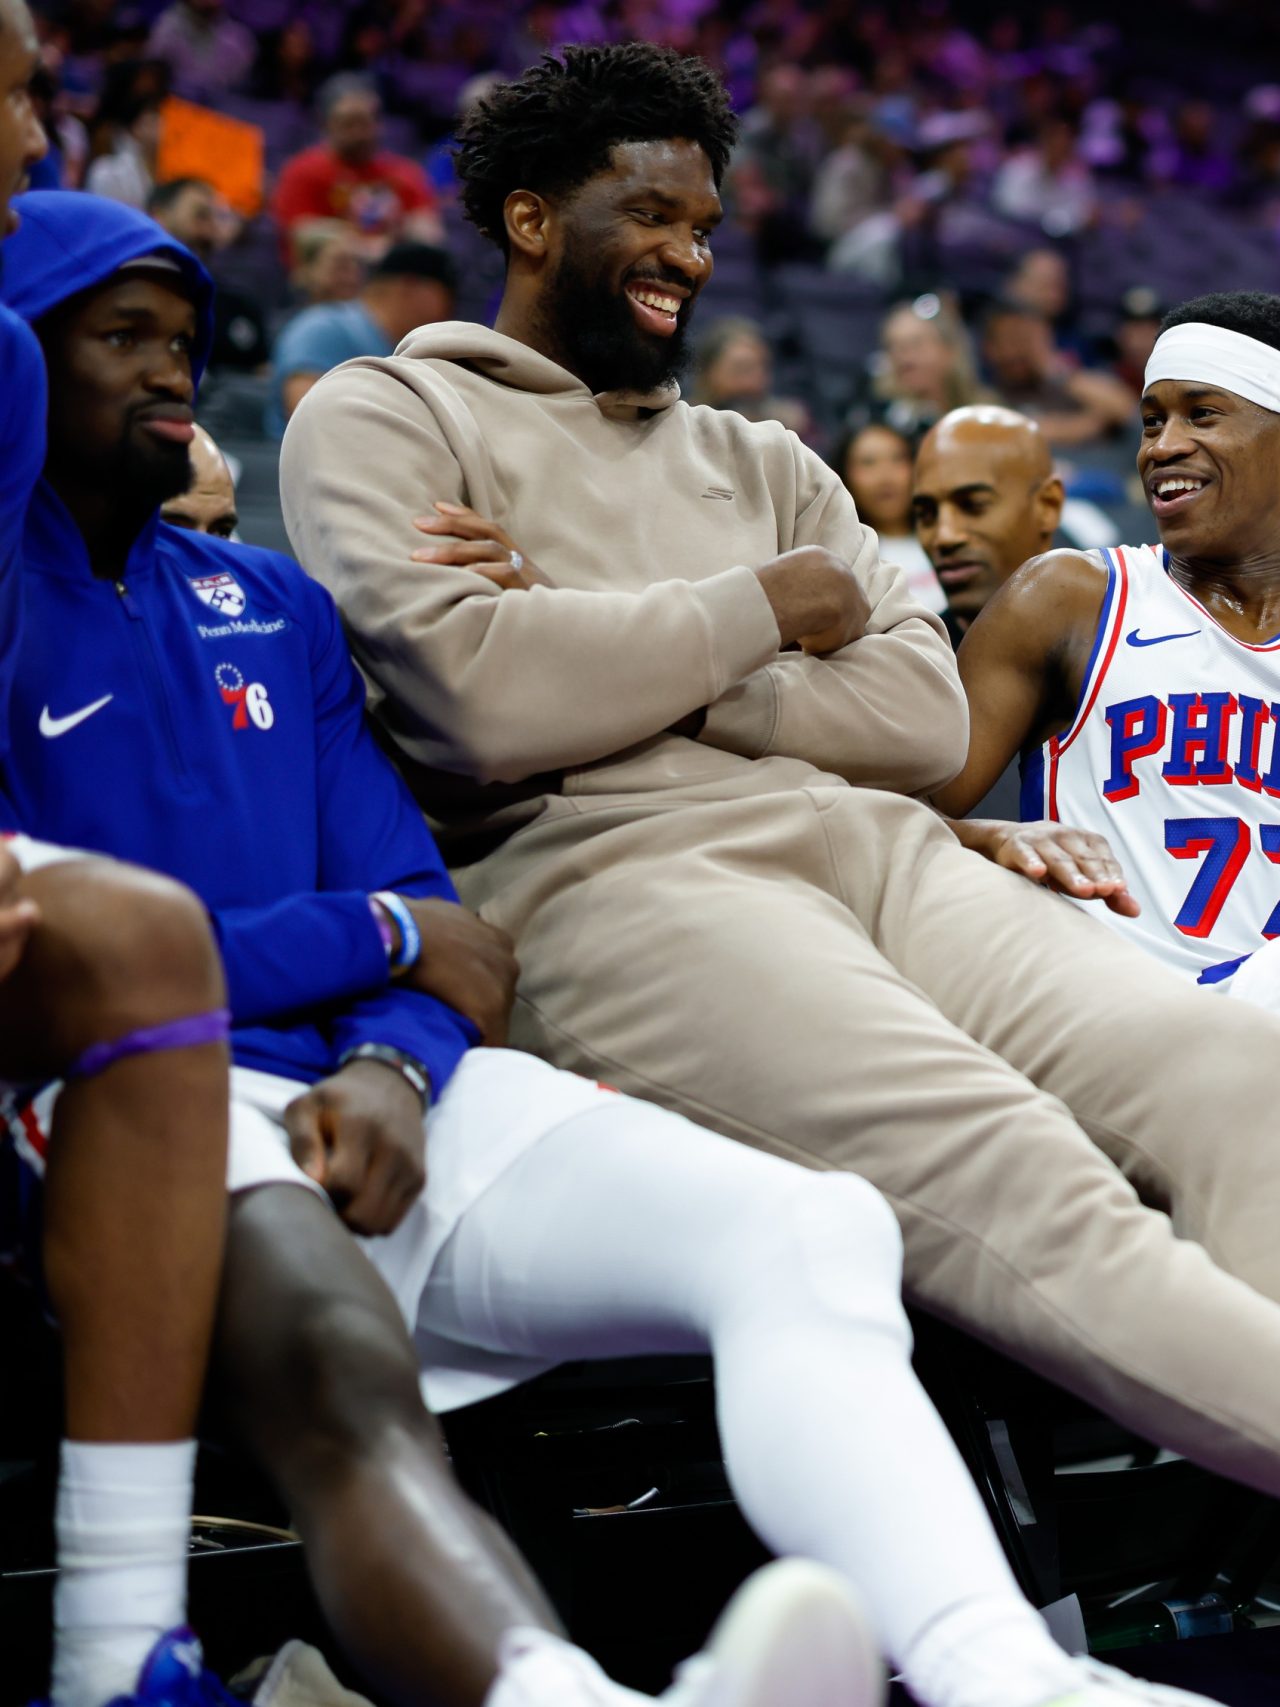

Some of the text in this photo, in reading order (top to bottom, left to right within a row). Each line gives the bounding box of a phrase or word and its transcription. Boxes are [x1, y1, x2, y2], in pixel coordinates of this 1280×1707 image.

[198, 618, 285, 638] Penn Medicine
[220, 682, 274, 731] 76
